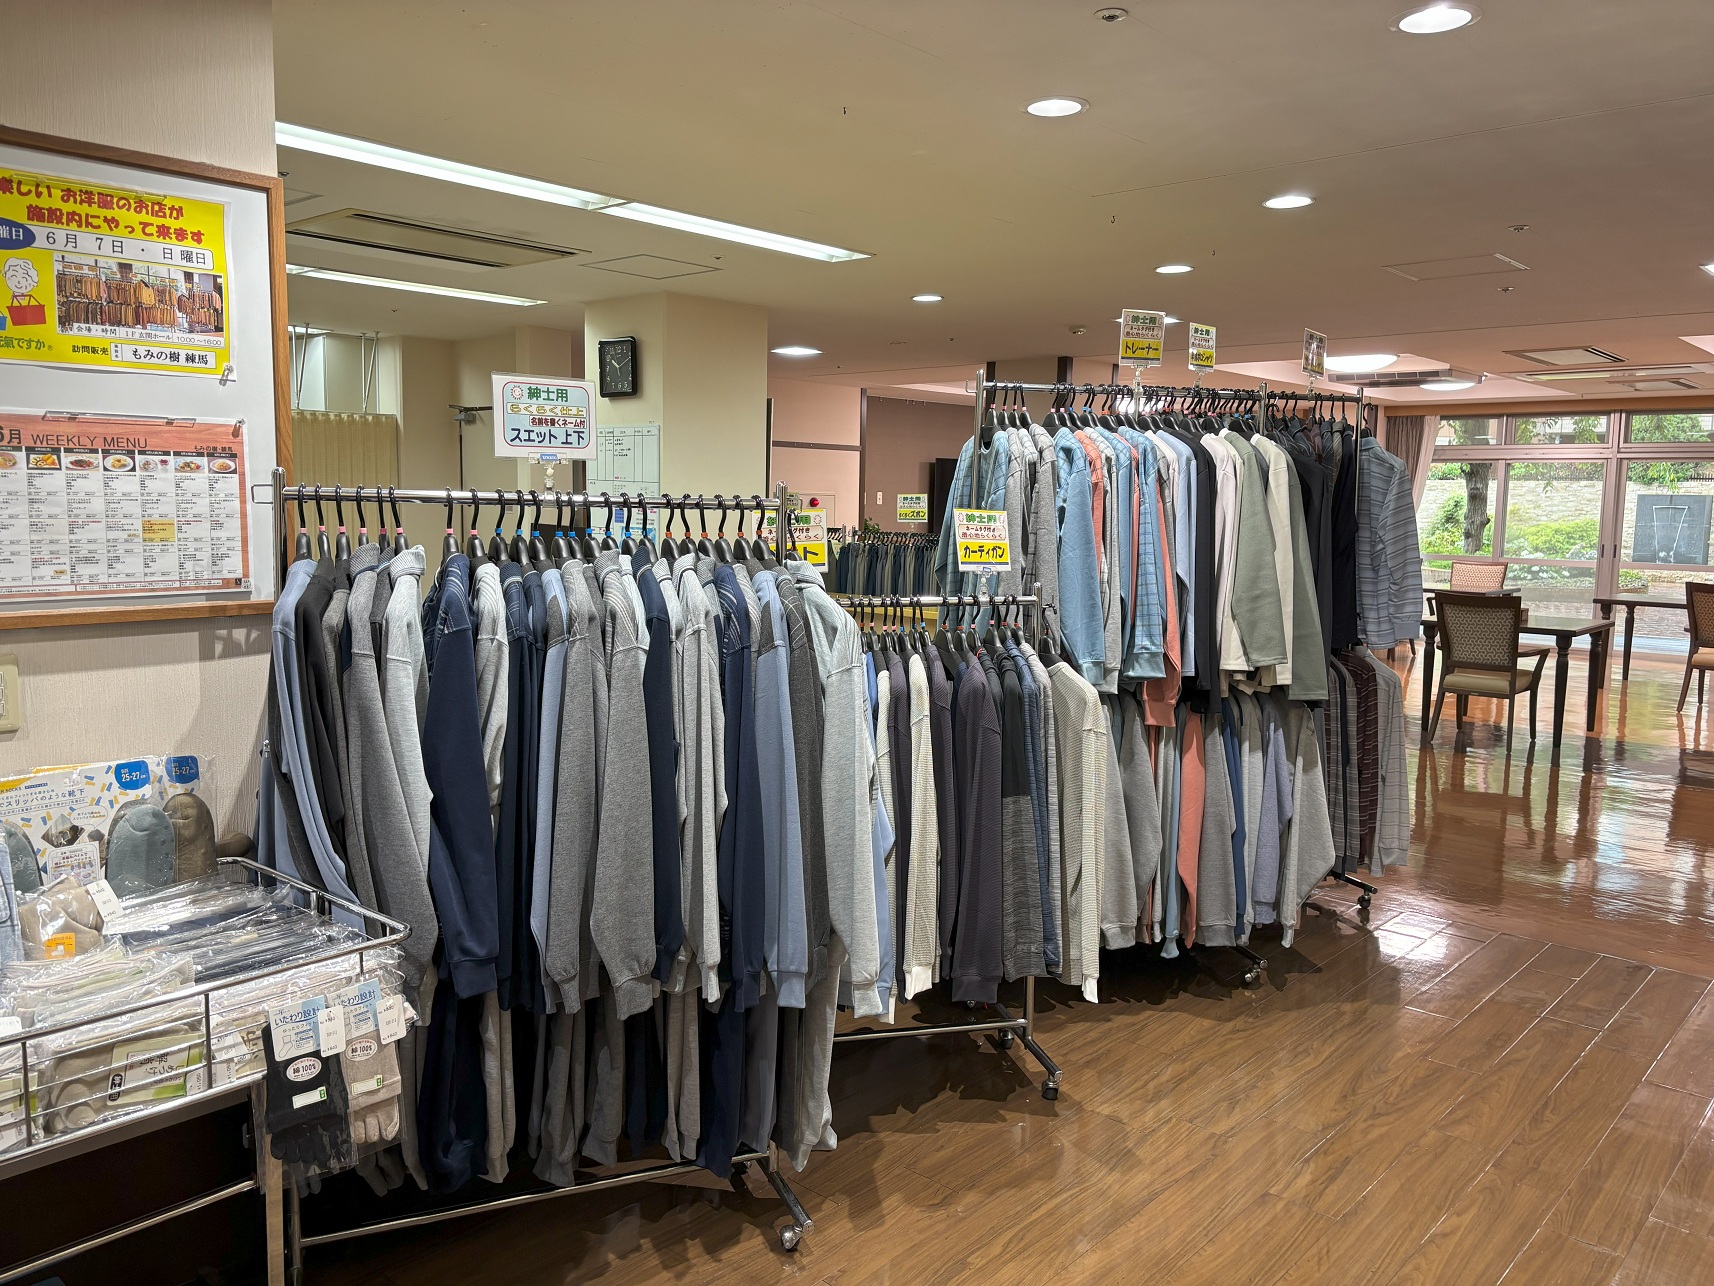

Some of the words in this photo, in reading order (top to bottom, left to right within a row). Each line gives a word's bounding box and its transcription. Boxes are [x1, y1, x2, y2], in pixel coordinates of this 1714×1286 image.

[61, 187, 184, 220] お洋服のお店が
[26, 204, 205, 245] 施設内にやって来ます
[1131, 315, 1157, 325] 紳士用
[72, 345, 109, 356] 訪問販売
[1125, 341, 1159, 356] トレーナー
[527, 386, 569, 402] 紳士用
[510, 404, 584, 417] らくらく仕上
[531, 417, 585, 428] 名前を書くネーム付
[31, 434, 97, 447] WEEKLY
[103, 436, 148, 449] MENU
[767, 515, 811, 526] 紳用
[965, 513, 997, 524] 紳士用
[964, 545, 1005, 559] カーディガン
[121, 772, 140, 782] 25-27
[302, 1063, 317, 1072] 100%
